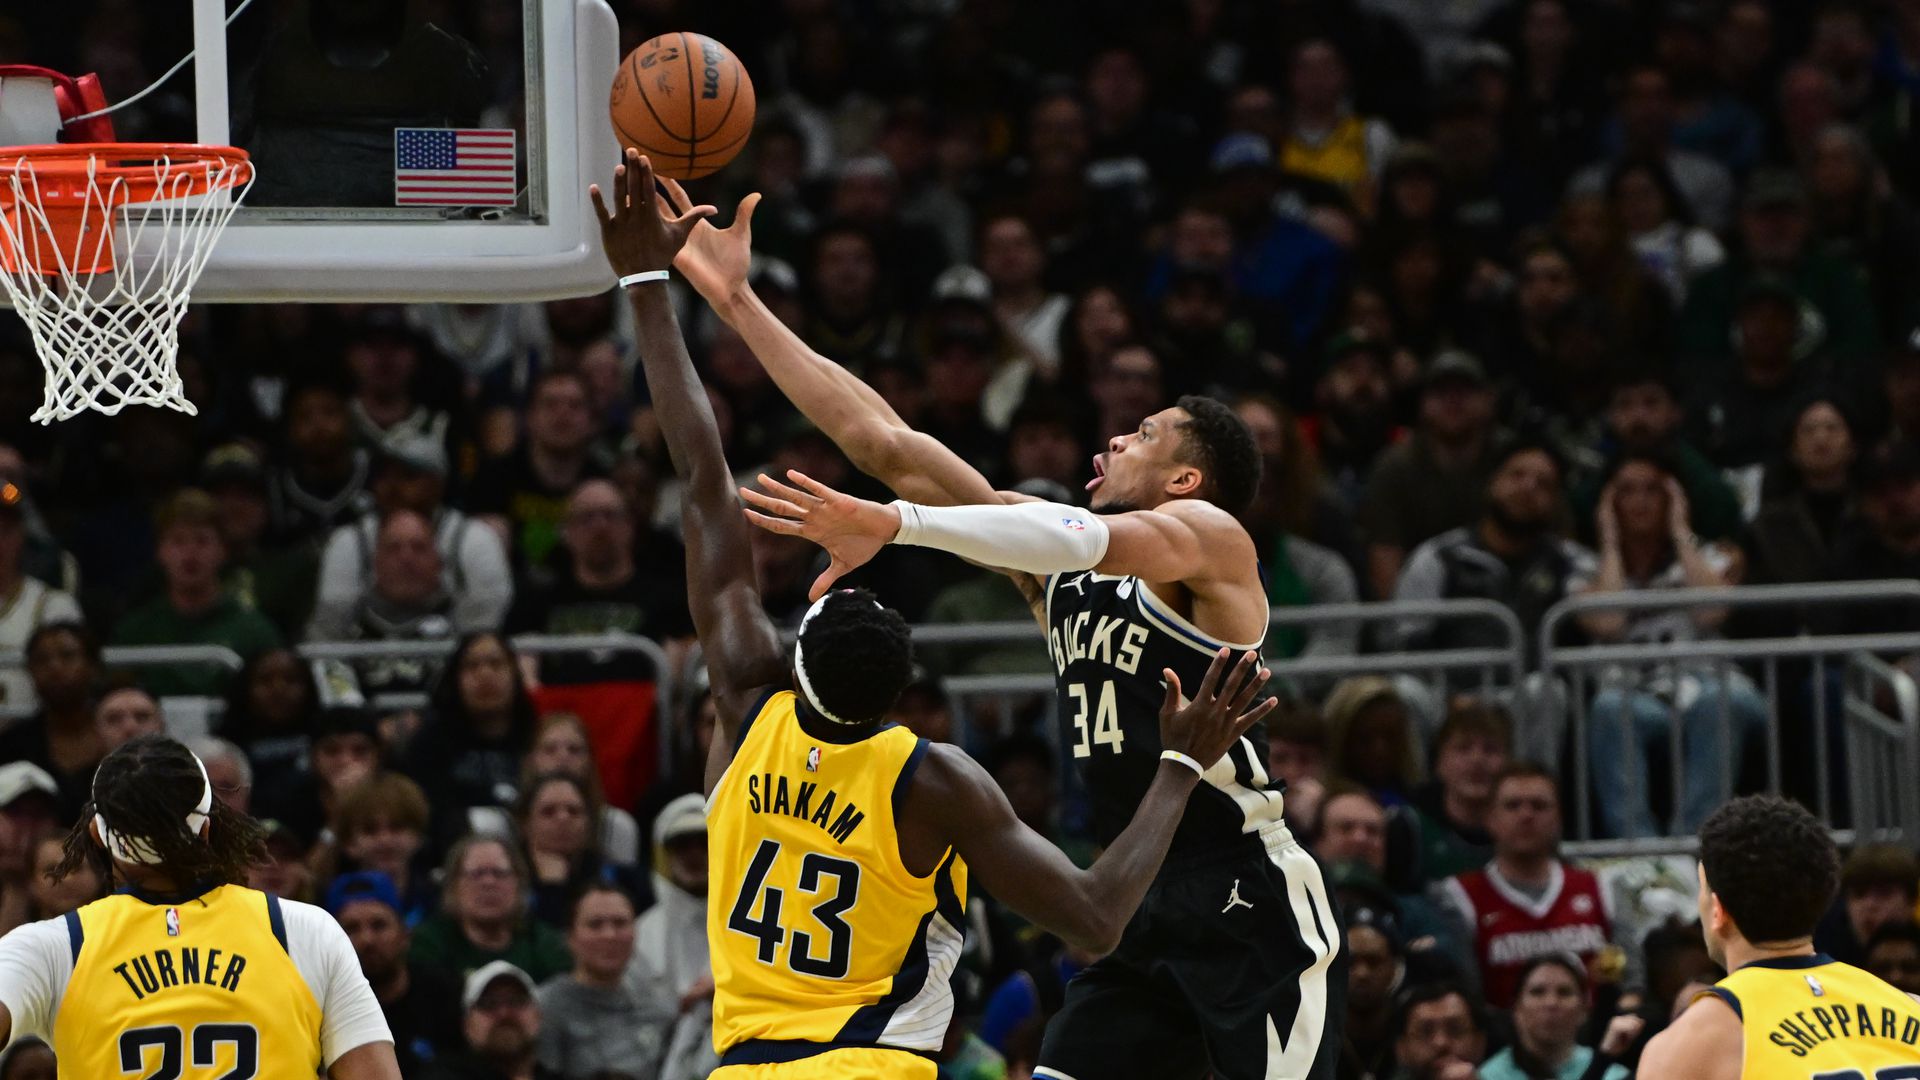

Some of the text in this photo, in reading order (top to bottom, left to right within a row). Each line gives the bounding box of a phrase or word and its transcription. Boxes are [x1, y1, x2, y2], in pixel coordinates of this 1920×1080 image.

[1052, 611, 1149, 676] BUCKS
[1069, 680, 1124, 758] 34
[749, 773, 865, 845] SIAKAM
[727, 838, 862, 980] 43
[113, 947, 247, 1000] TURNER
[1769, 1003, 1920, 1057] SHEPPARD
